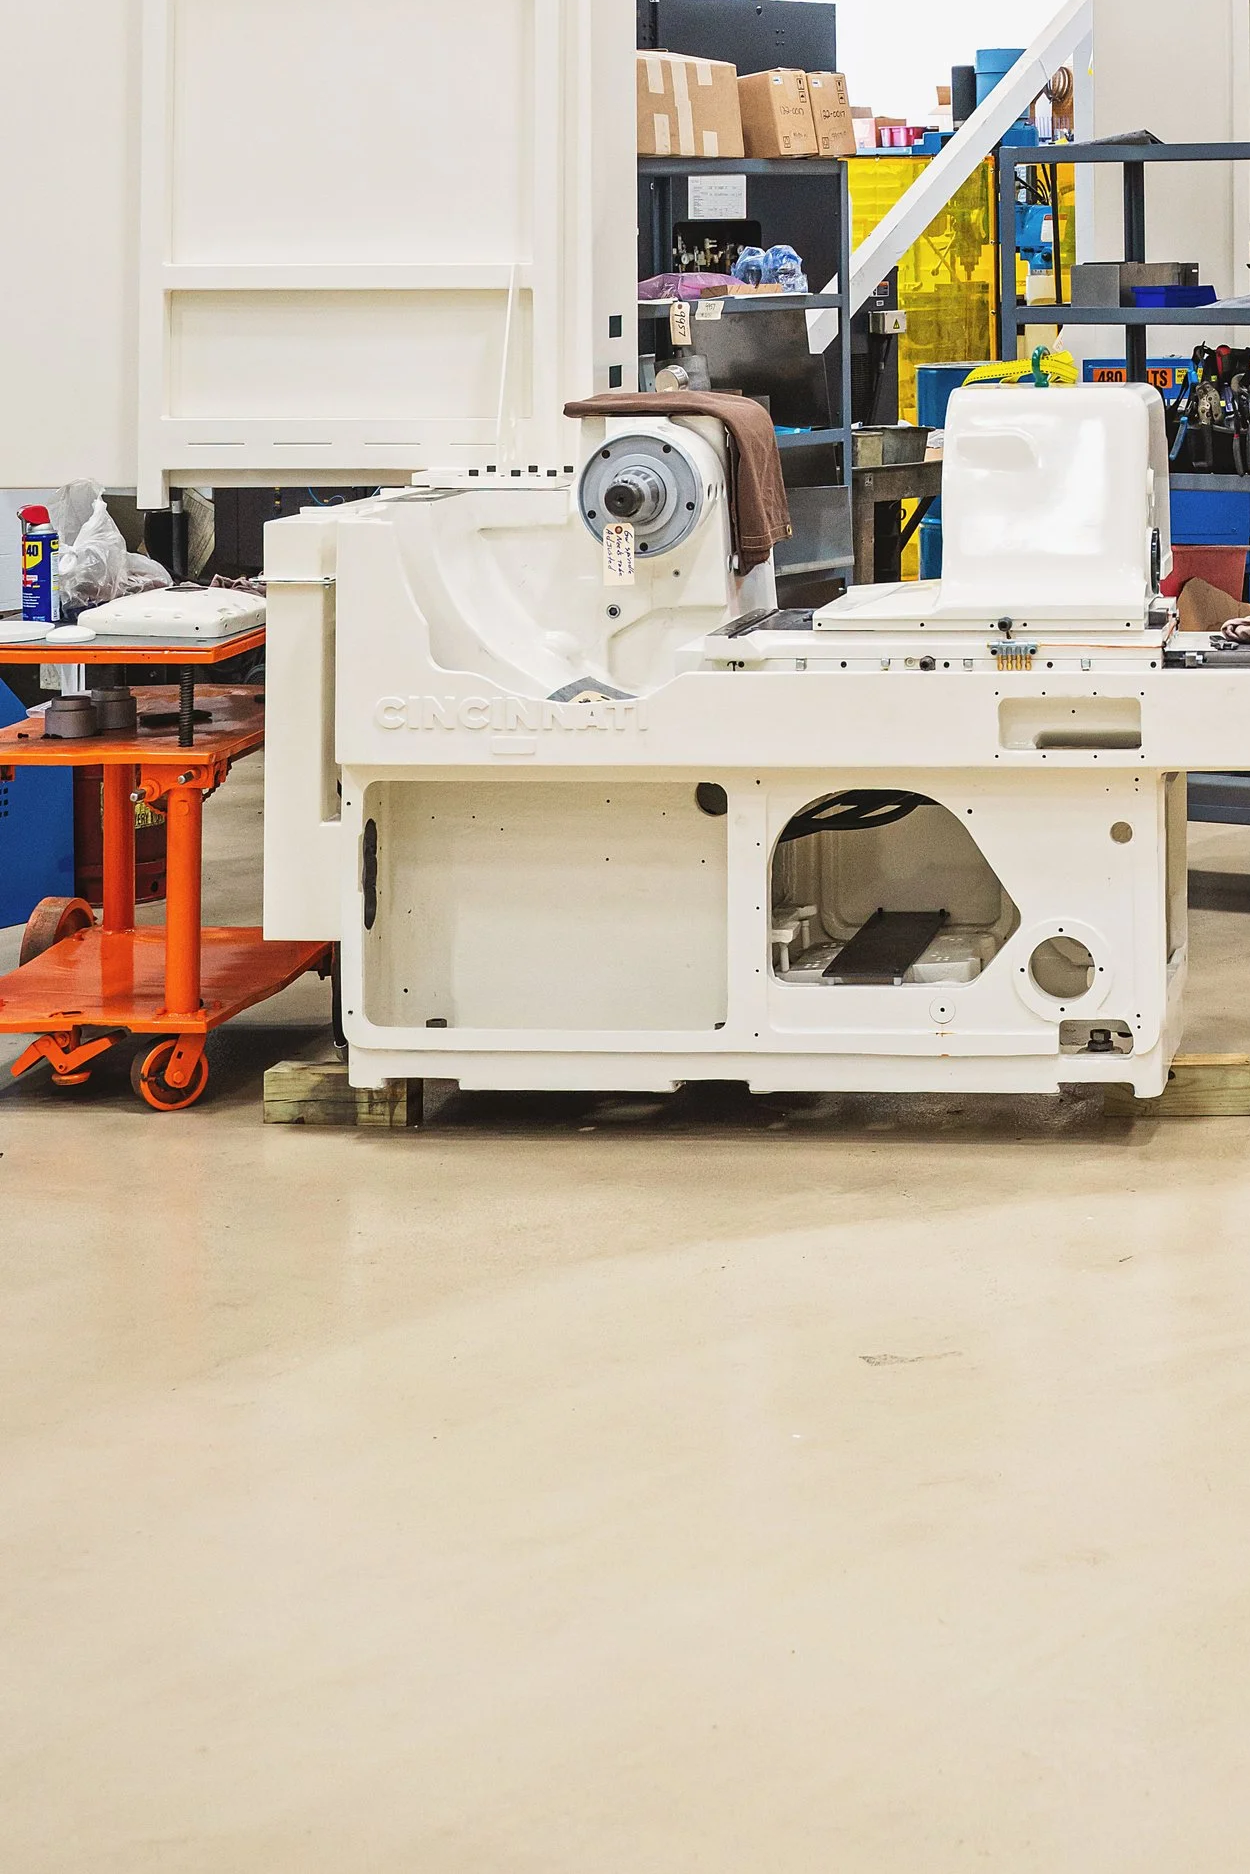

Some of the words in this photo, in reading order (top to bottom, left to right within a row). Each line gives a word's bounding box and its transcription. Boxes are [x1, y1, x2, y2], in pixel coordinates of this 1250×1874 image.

[1098, 370, 1123, 383] 480
[1146, 369, 1168, 388] LTS
[375, 696, 650, 731] CINCINNATI
